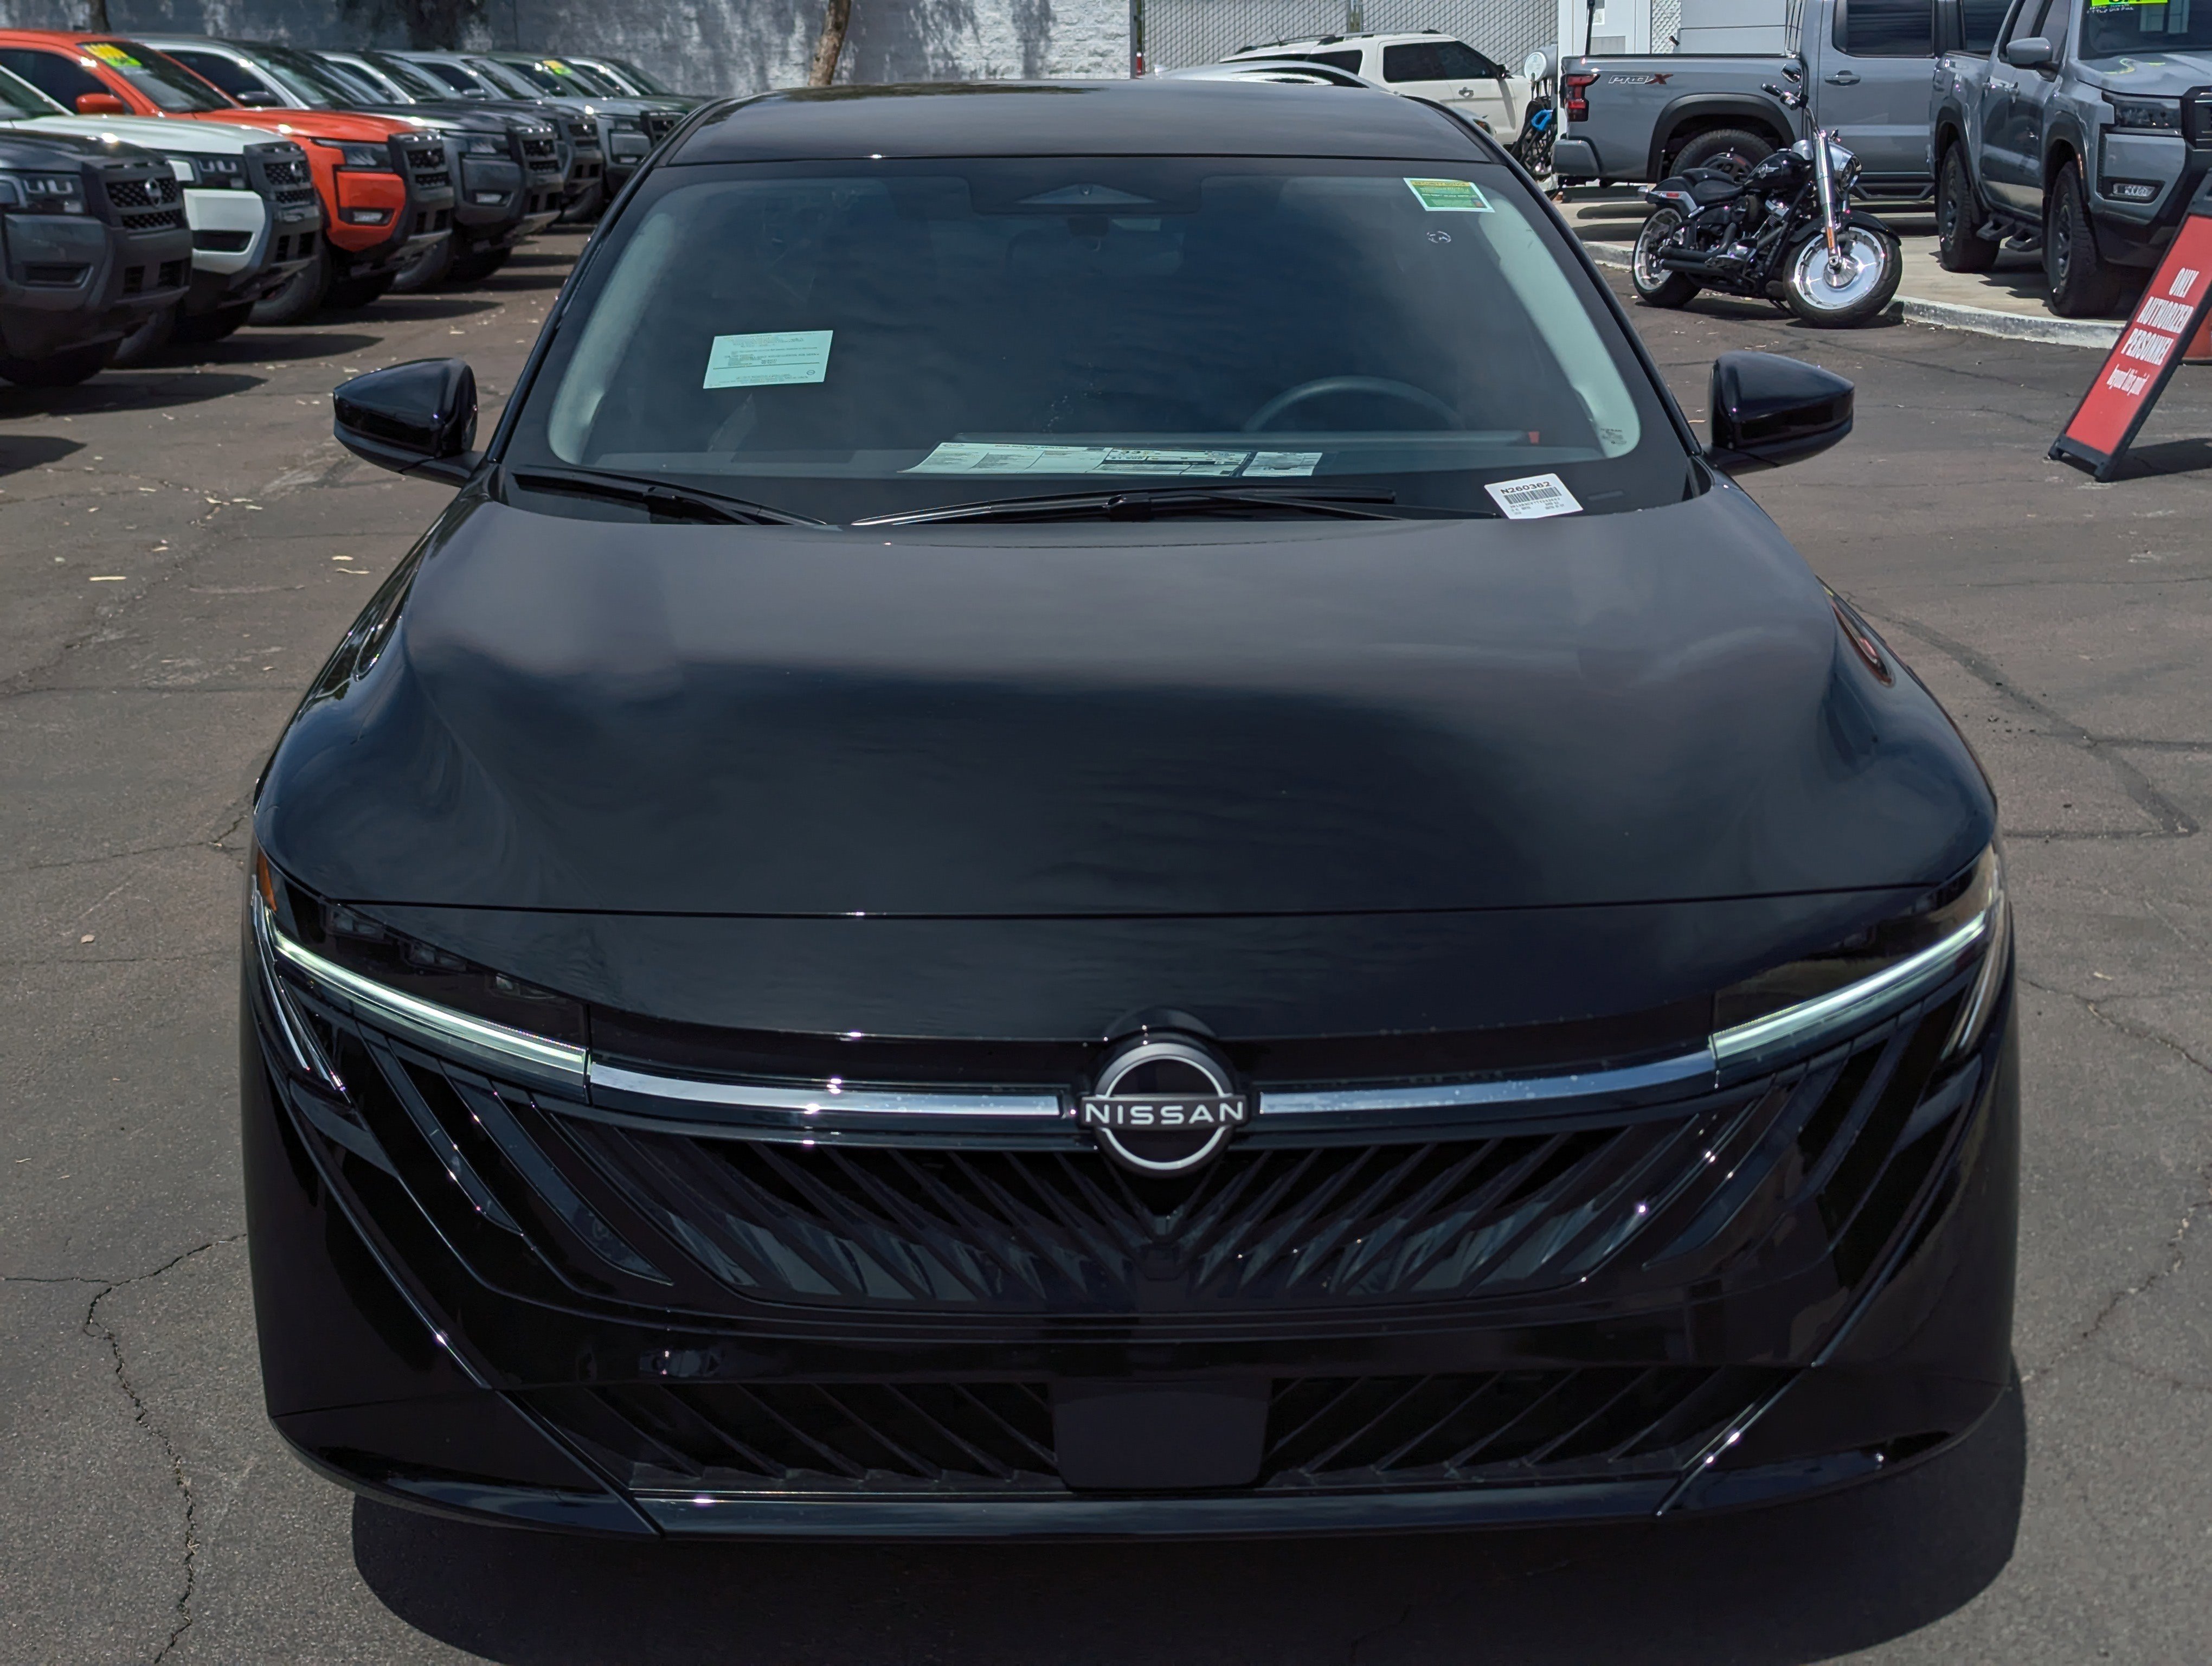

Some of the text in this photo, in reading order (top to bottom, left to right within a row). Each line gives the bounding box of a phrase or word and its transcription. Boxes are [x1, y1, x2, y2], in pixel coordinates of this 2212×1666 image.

[2169, 267, 2200, 298] ONLY
[2136, 296, 2194, 334] AUTHORIZED
[2120, 328, 2174, 366] PERSONNEL
[1500, 481, 1552, 495] N260362
[1084, 1101, 1244, 1125] NISSAN
